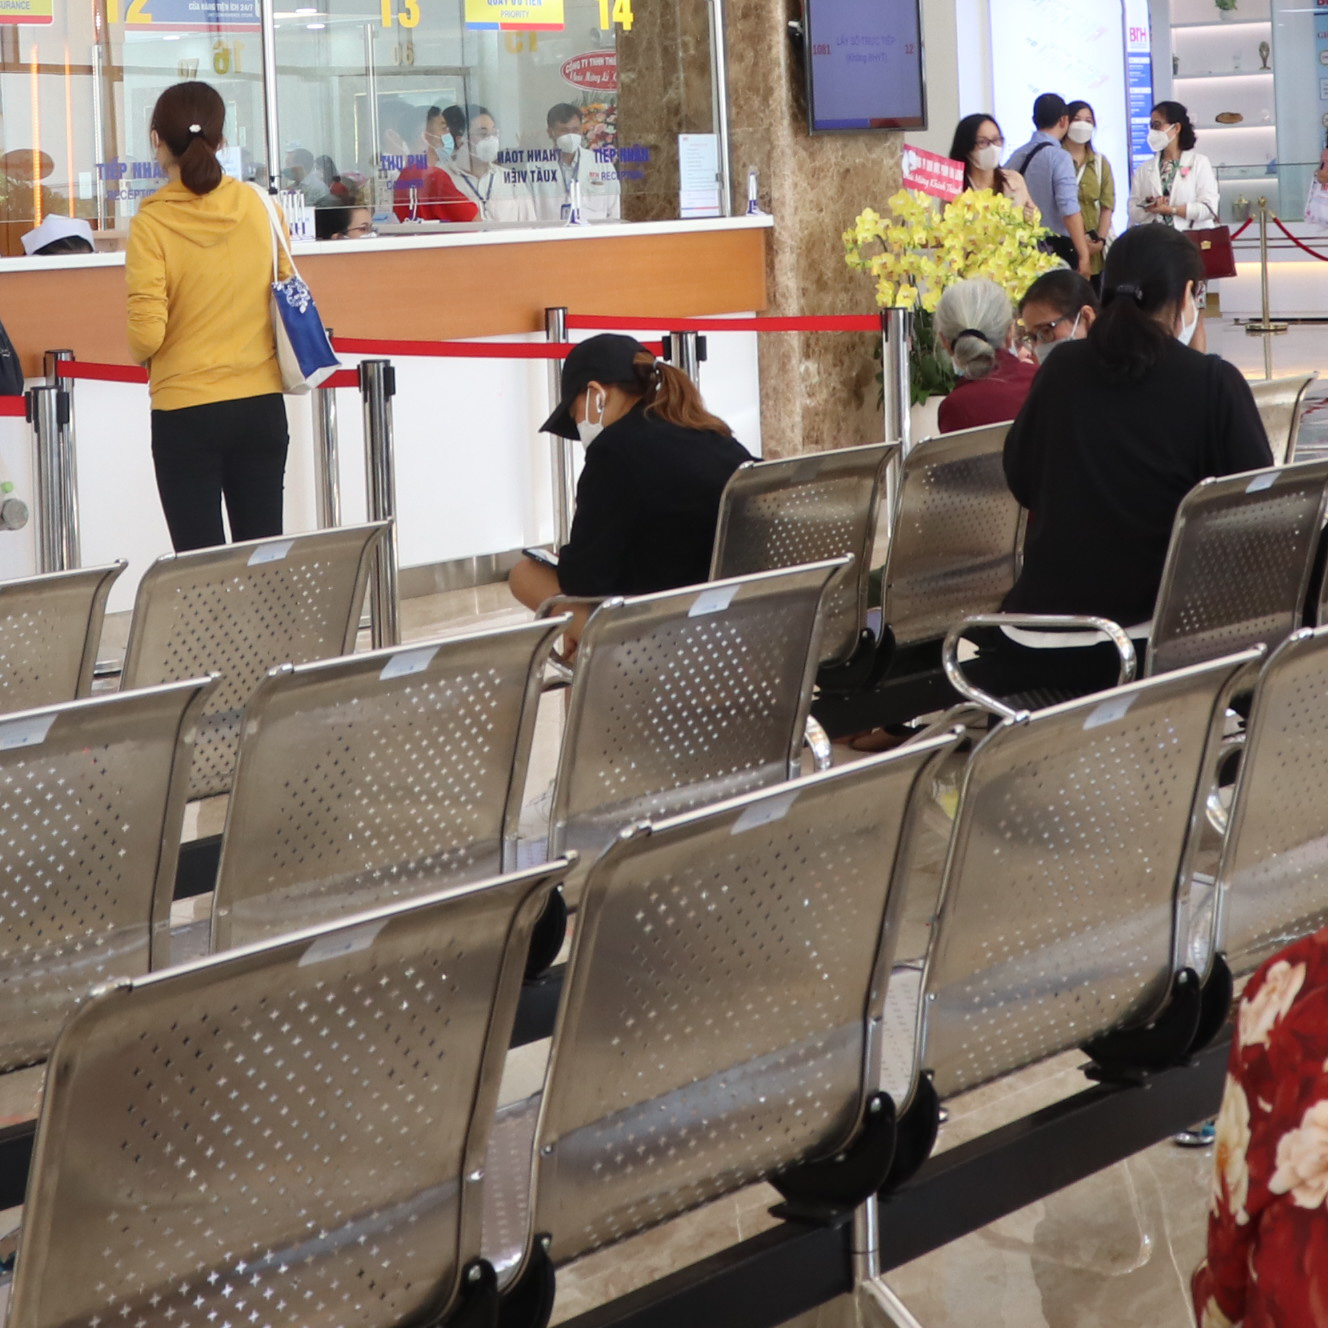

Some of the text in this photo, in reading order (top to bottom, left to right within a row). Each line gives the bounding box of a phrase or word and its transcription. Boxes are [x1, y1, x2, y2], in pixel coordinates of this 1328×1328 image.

[500, 10, 530, 19] PRIORITY
[1129, 27, 1147, 42] BTH
[905, 44, 914, 55] 12
[593, 143, 617, 163] TIẾP
